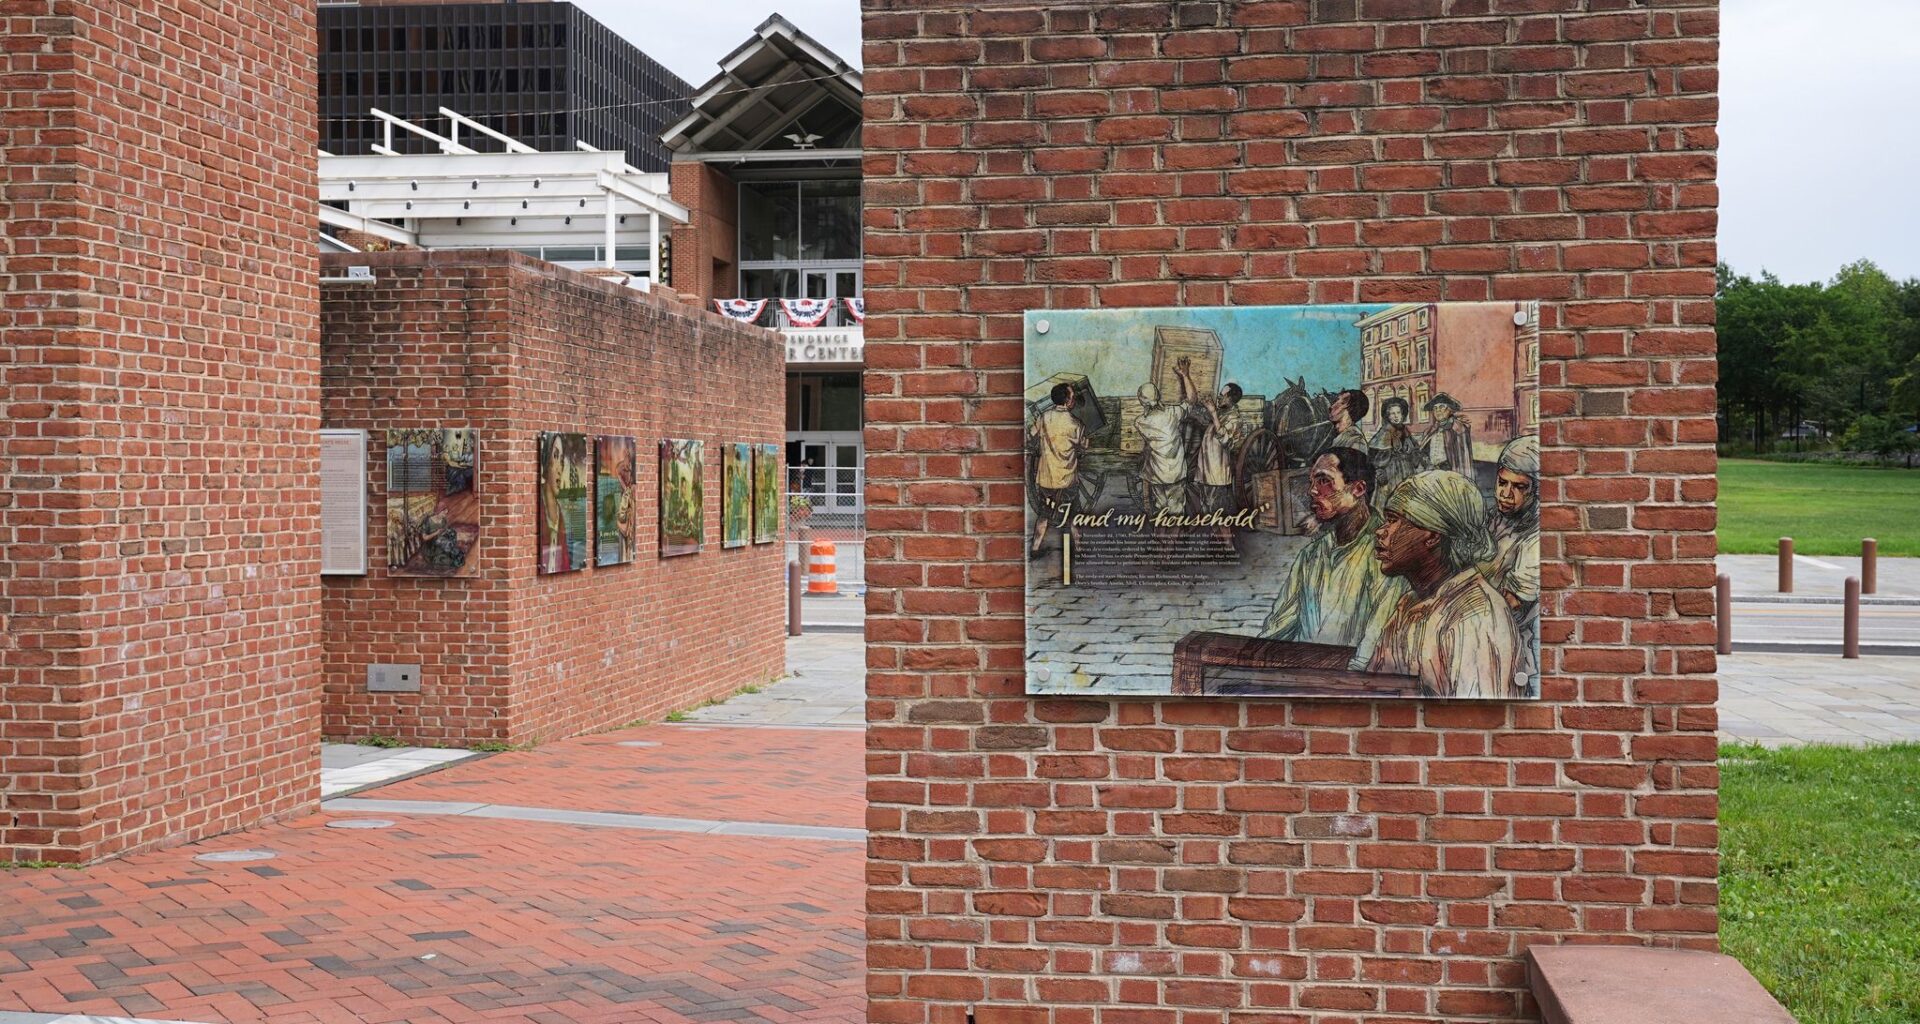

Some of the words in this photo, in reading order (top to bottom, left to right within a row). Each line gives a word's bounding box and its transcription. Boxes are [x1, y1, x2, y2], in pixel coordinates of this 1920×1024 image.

[790, 334, 849, 344] ENDENCE
[804, 345, 864, 360] CENTE
[1072, 507, 1115, 528] and
[1113, 513, 1147, 535] my
